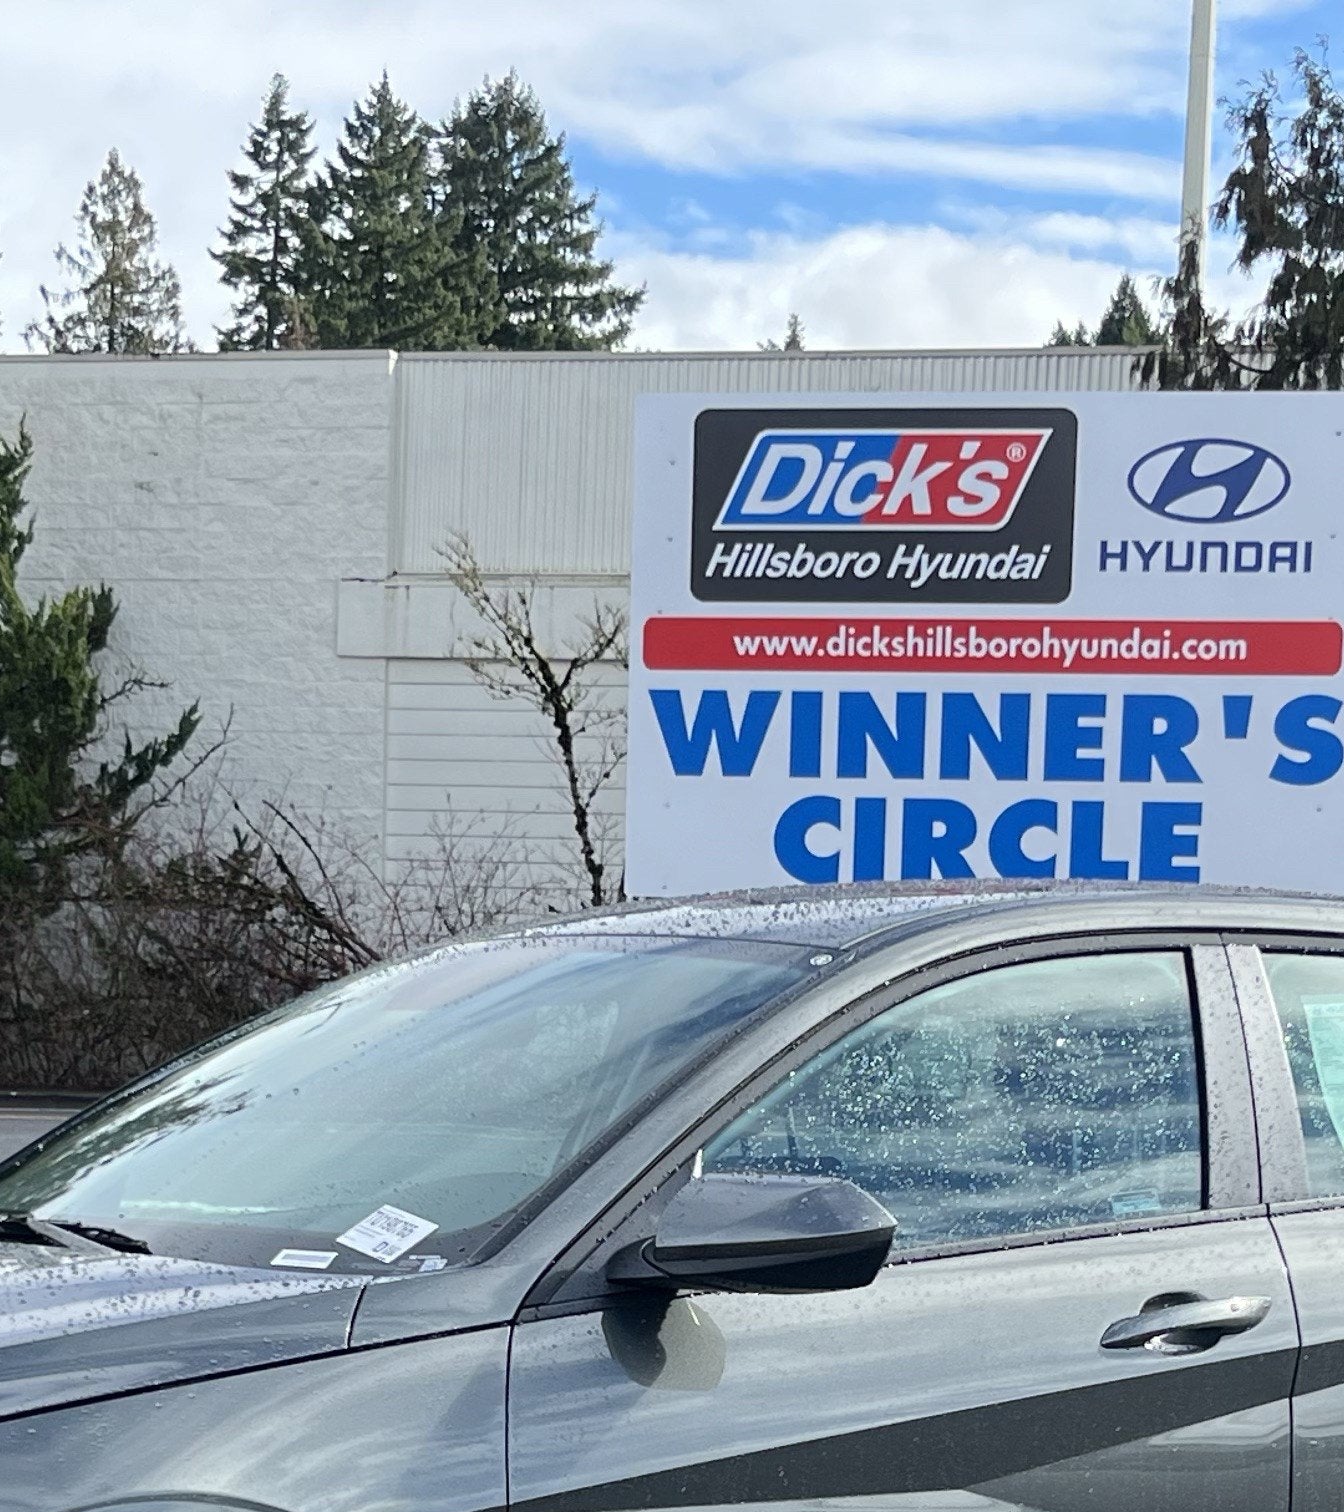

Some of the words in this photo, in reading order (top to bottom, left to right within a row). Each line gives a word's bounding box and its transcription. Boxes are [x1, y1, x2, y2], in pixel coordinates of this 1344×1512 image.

[705, 543, 881, 580] Hillsboro
[887, 544, 1052, 588] Hyundai
[1099, 540, 1312, 573] HYUNDAI
[733, 625, 1248, 668] www.dickshillsborohyundai.com
[648, 689, 1344, 786] WINNER'S
[774, 795, 1204, 884] CIRCLE
